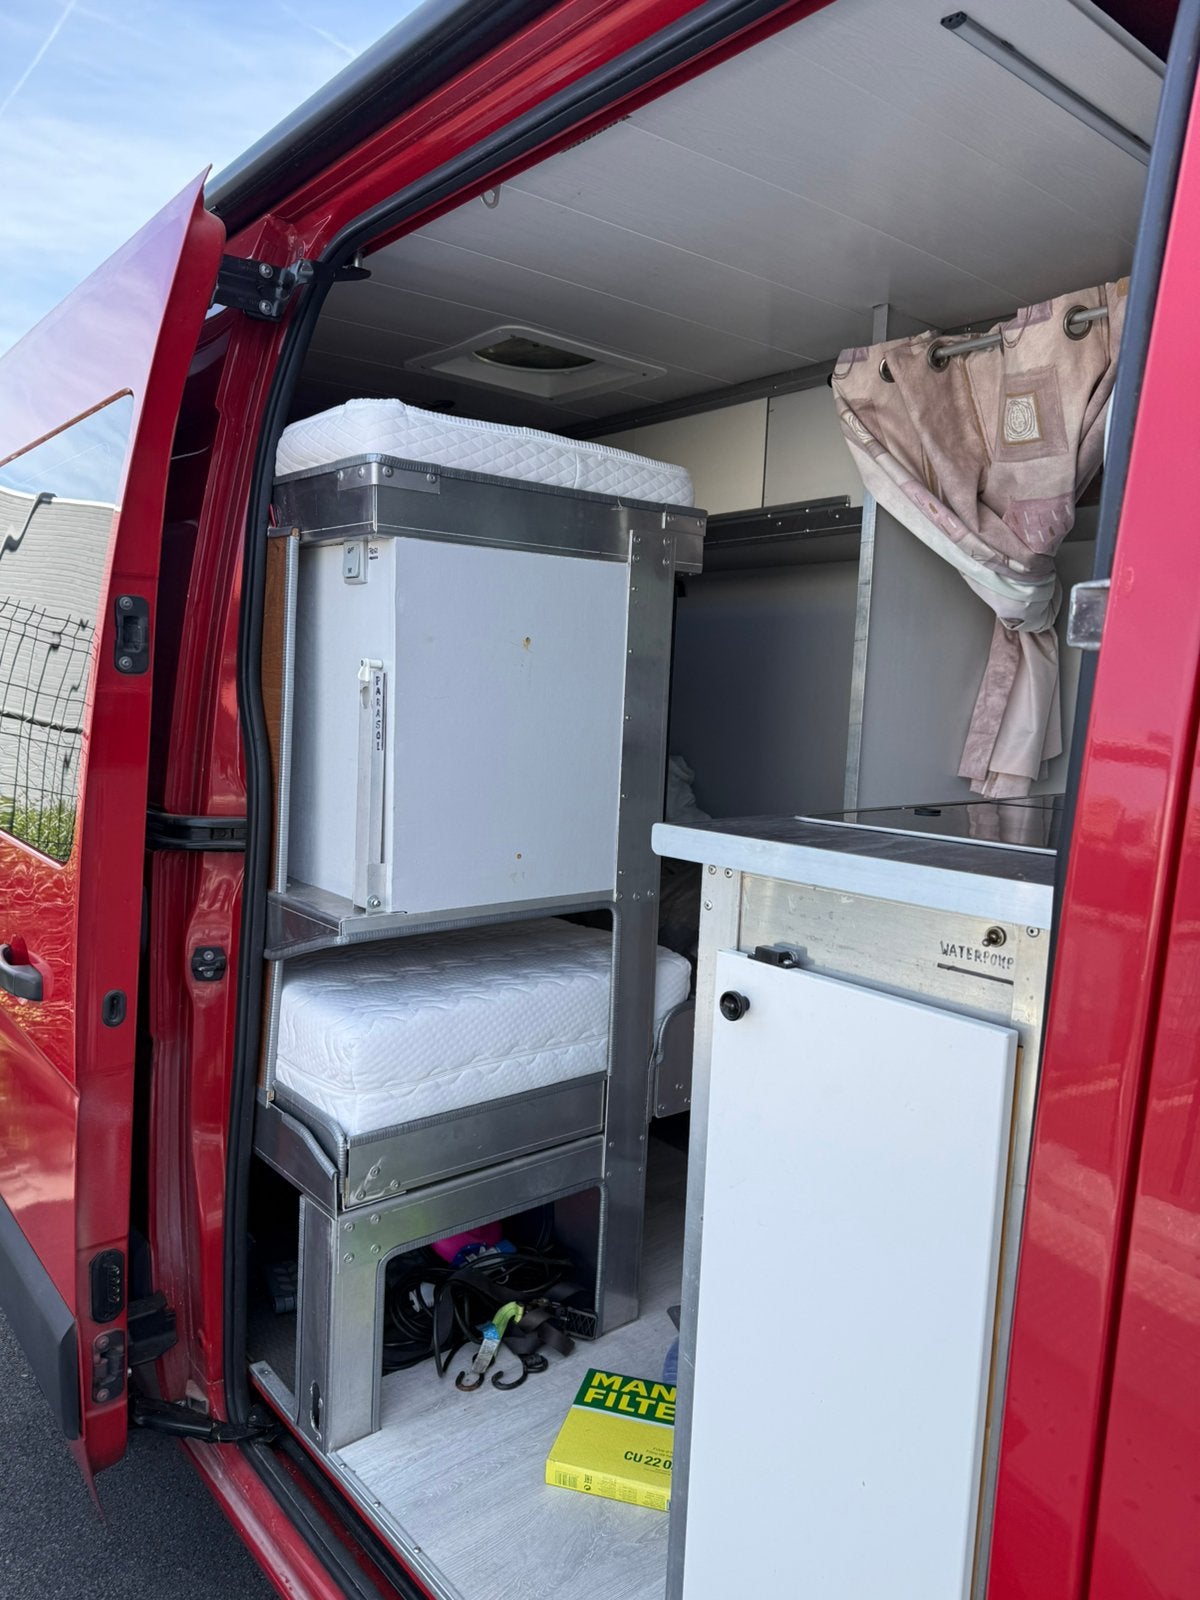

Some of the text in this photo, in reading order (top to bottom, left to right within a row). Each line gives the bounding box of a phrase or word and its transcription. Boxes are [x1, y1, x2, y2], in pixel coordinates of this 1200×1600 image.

[940, 940, 1014, 970] WATERPOMP
[591, 1372, 677, 1402] MAN
[584, 1387, 676, 1421] FILTE
[623, 1450, 643, 1463] CU
[643, 1455, 662, 1468] 22
[662, 1459, 673, 1471] 0
